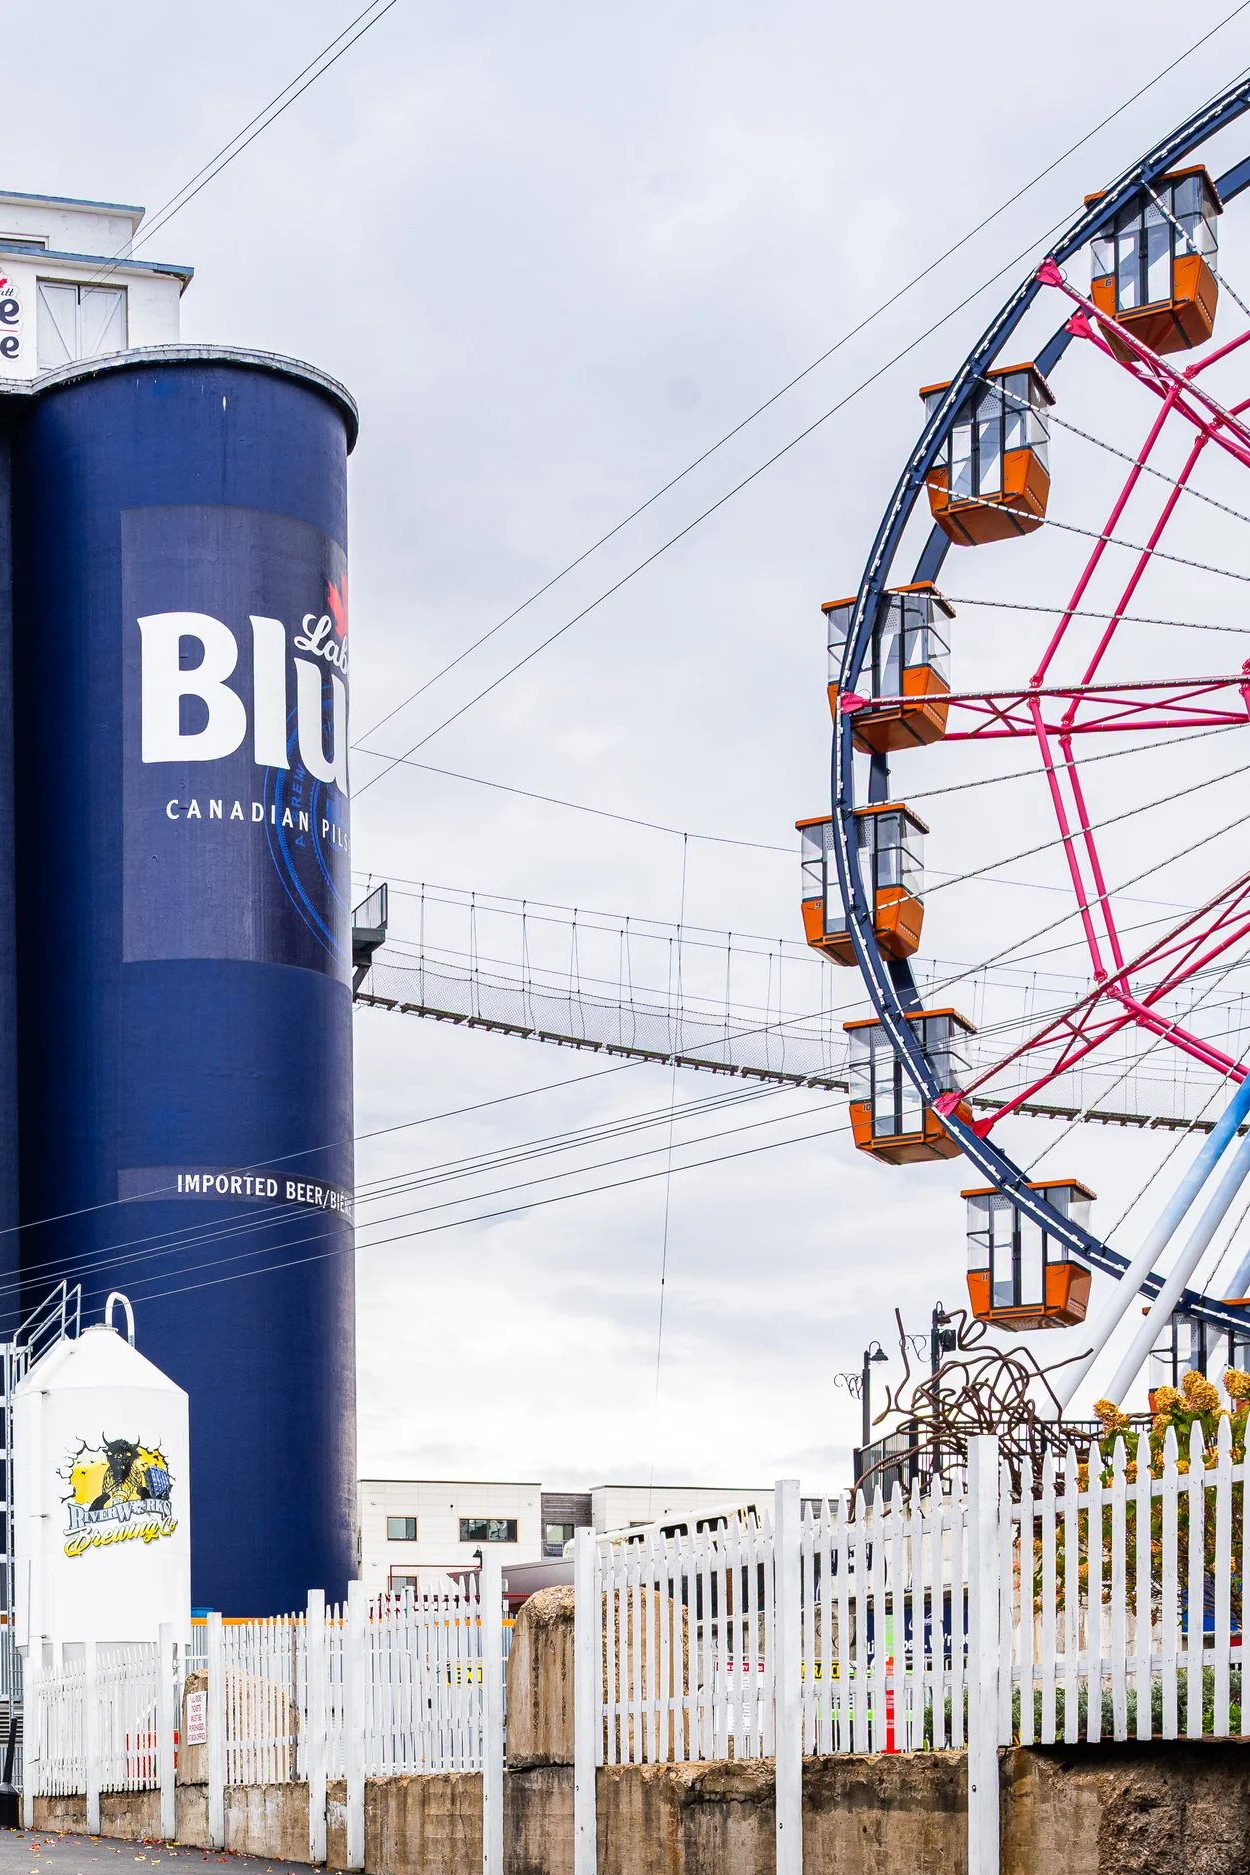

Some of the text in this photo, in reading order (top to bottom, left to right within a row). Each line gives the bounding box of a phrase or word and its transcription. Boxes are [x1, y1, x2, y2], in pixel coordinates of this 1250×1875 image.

[294, 613, 349, 677] Lab
[137, 612, 349, 799] Blu
[166, 799, 309, 832] CANADIAN
[177, 1174, 278, 1197] IMPORTED
[63, 1516, 161, 1558] Brewing
